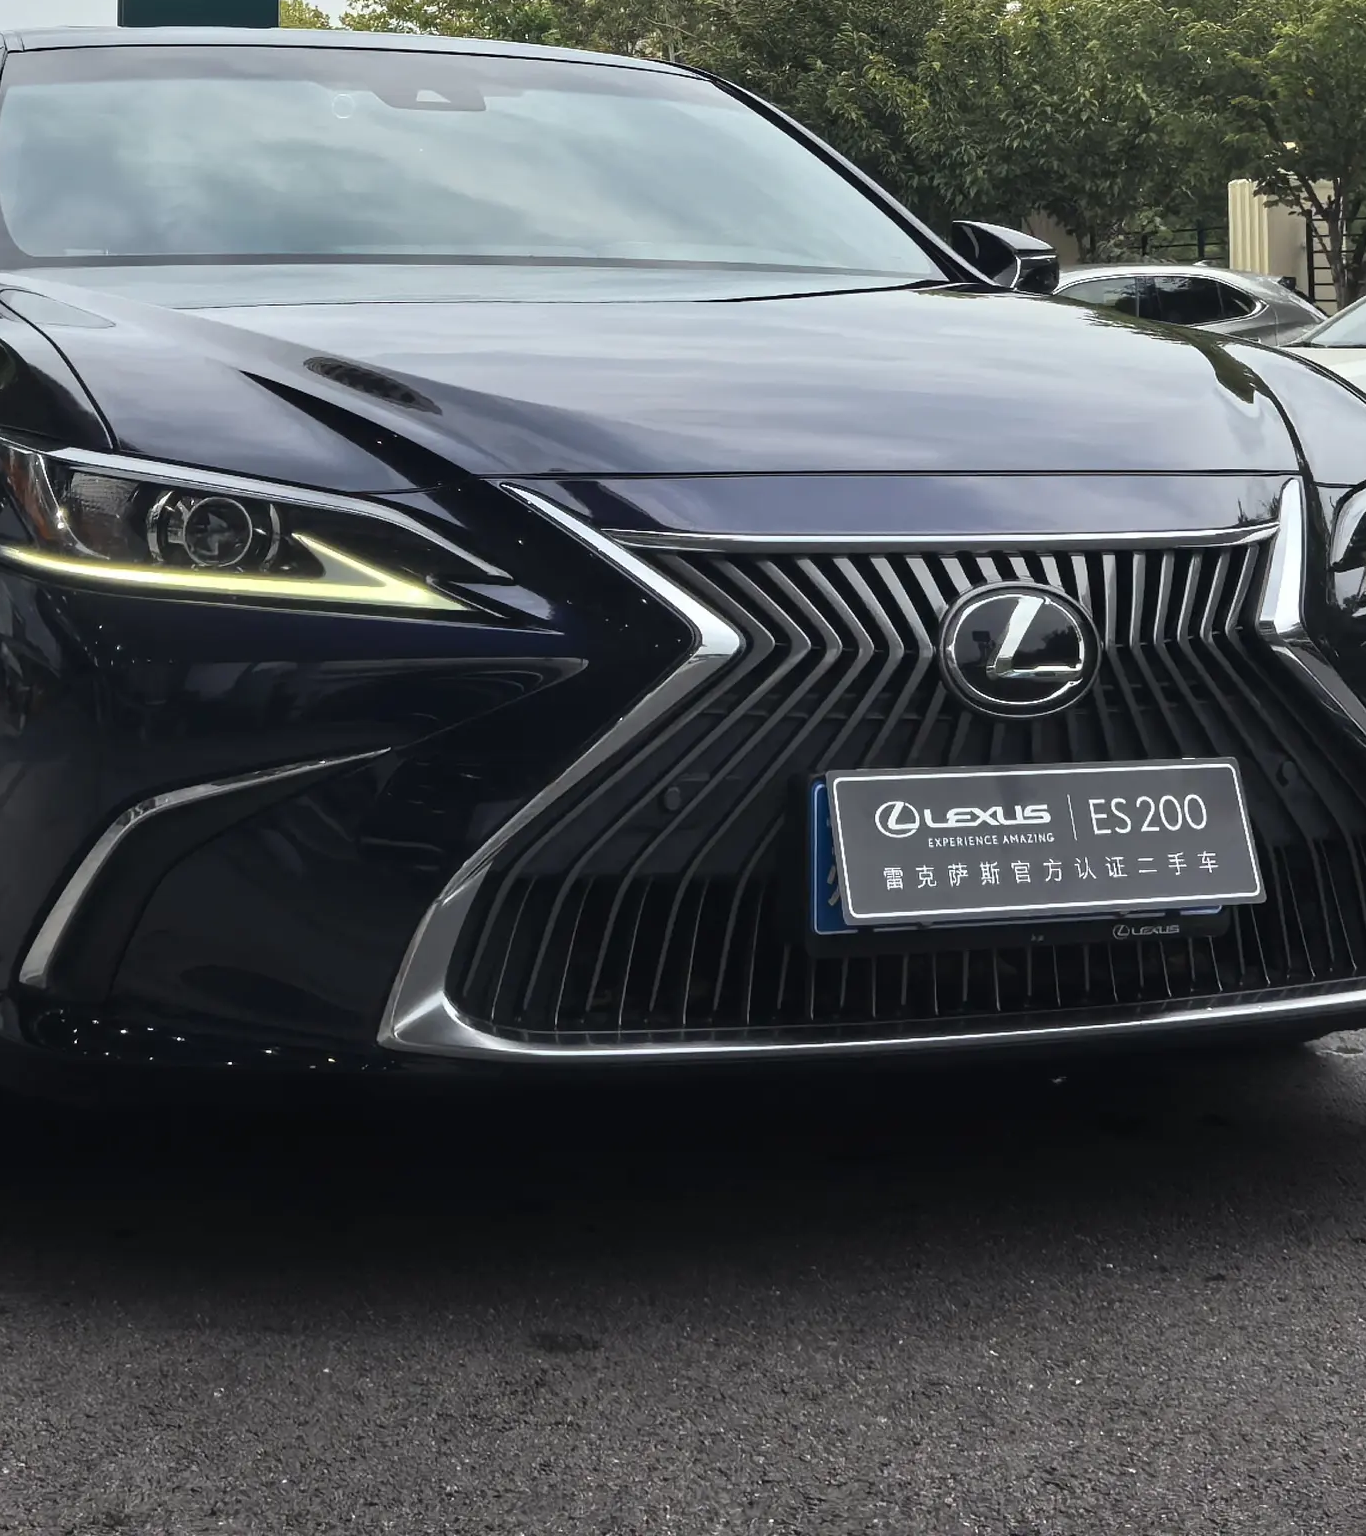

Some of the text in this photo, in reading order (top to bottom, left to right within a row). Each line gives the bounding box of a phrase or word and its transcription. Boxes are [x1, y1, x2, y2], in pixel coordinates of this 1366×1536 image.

[924, 804, 1052, 828] LEXUS
[928, 832, 1055, 848] EXPERIENCE AMAZING
[883, 850, 1219, 891] 雷克萨斯官方认证二手车
